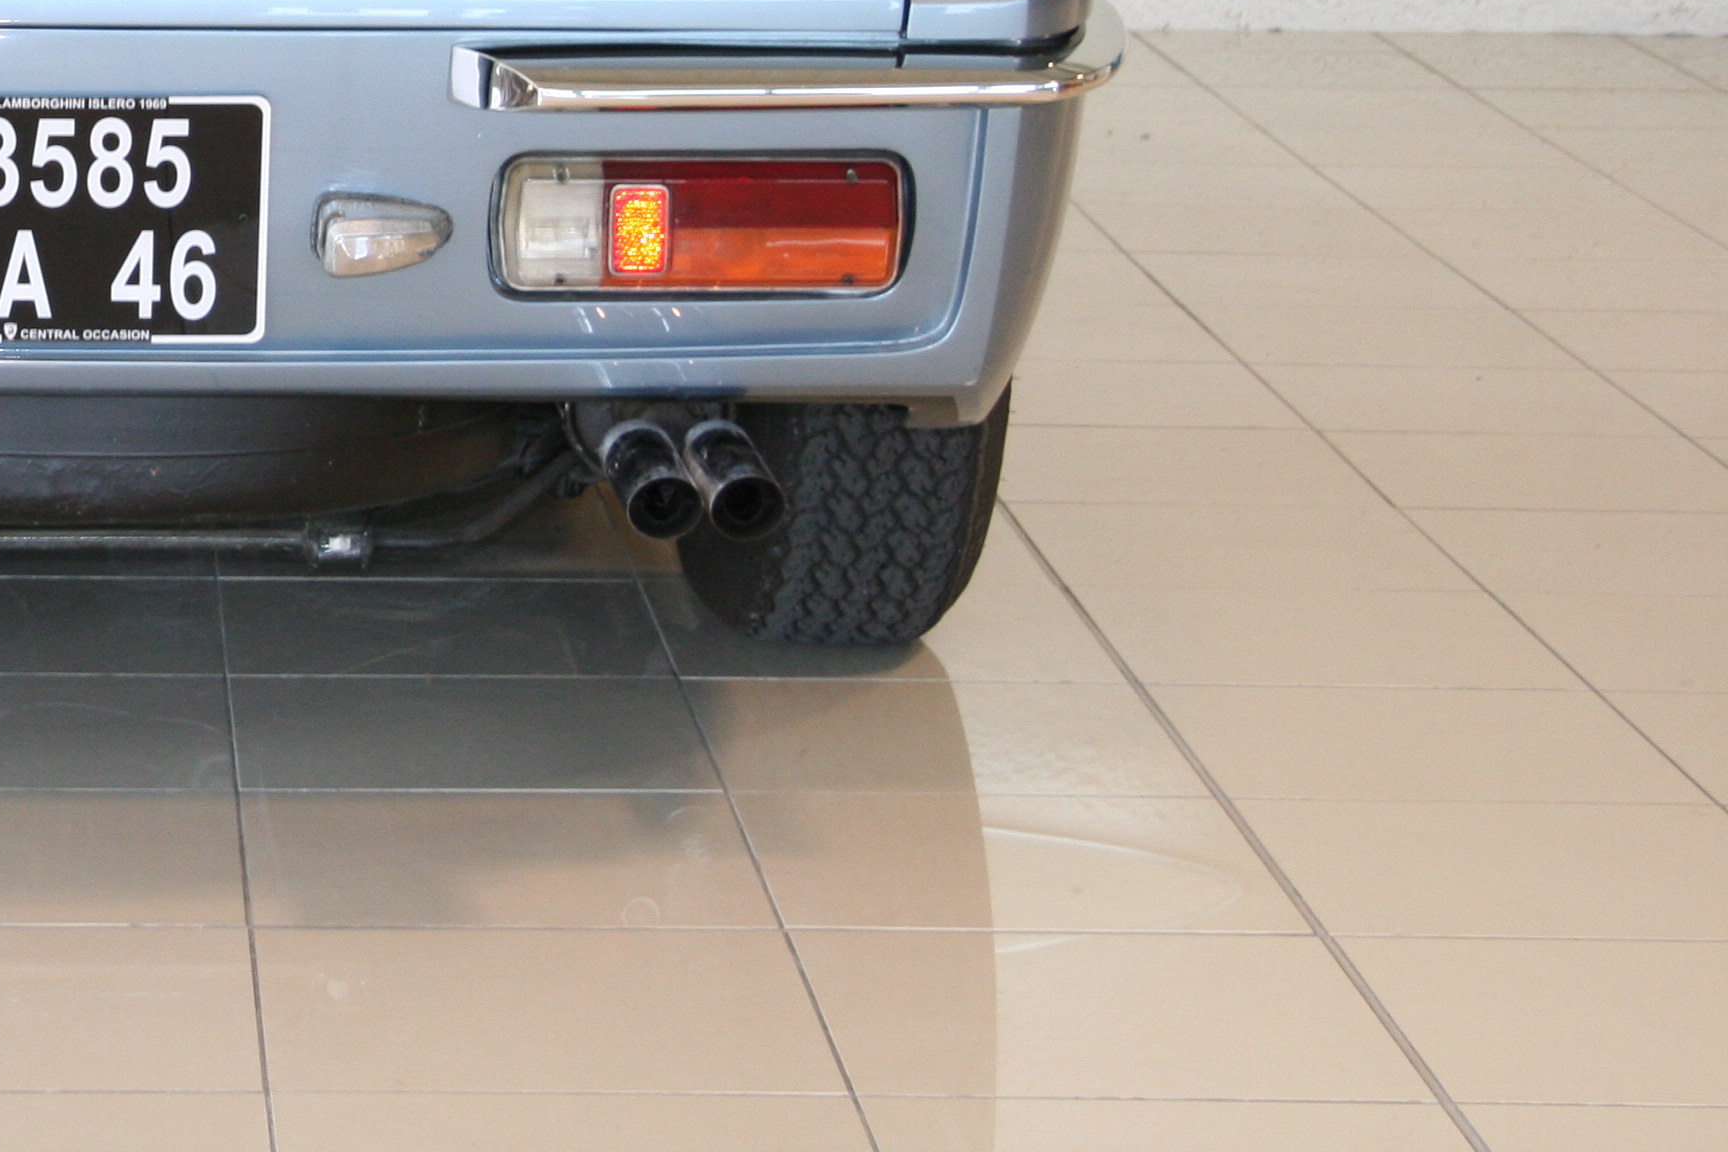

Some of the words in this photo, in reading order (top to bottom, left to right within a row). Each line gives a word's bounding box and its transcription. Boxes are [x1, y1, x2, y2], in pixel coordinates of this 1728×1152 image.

[88, 98, 136, 110] ISLERO
[139, 98, 168, 110] 1969
[110, 228, 217, 321] 46
[19, 328, 80, 341] CENTRAL
[82, 328, 151, 341] OCCASION
